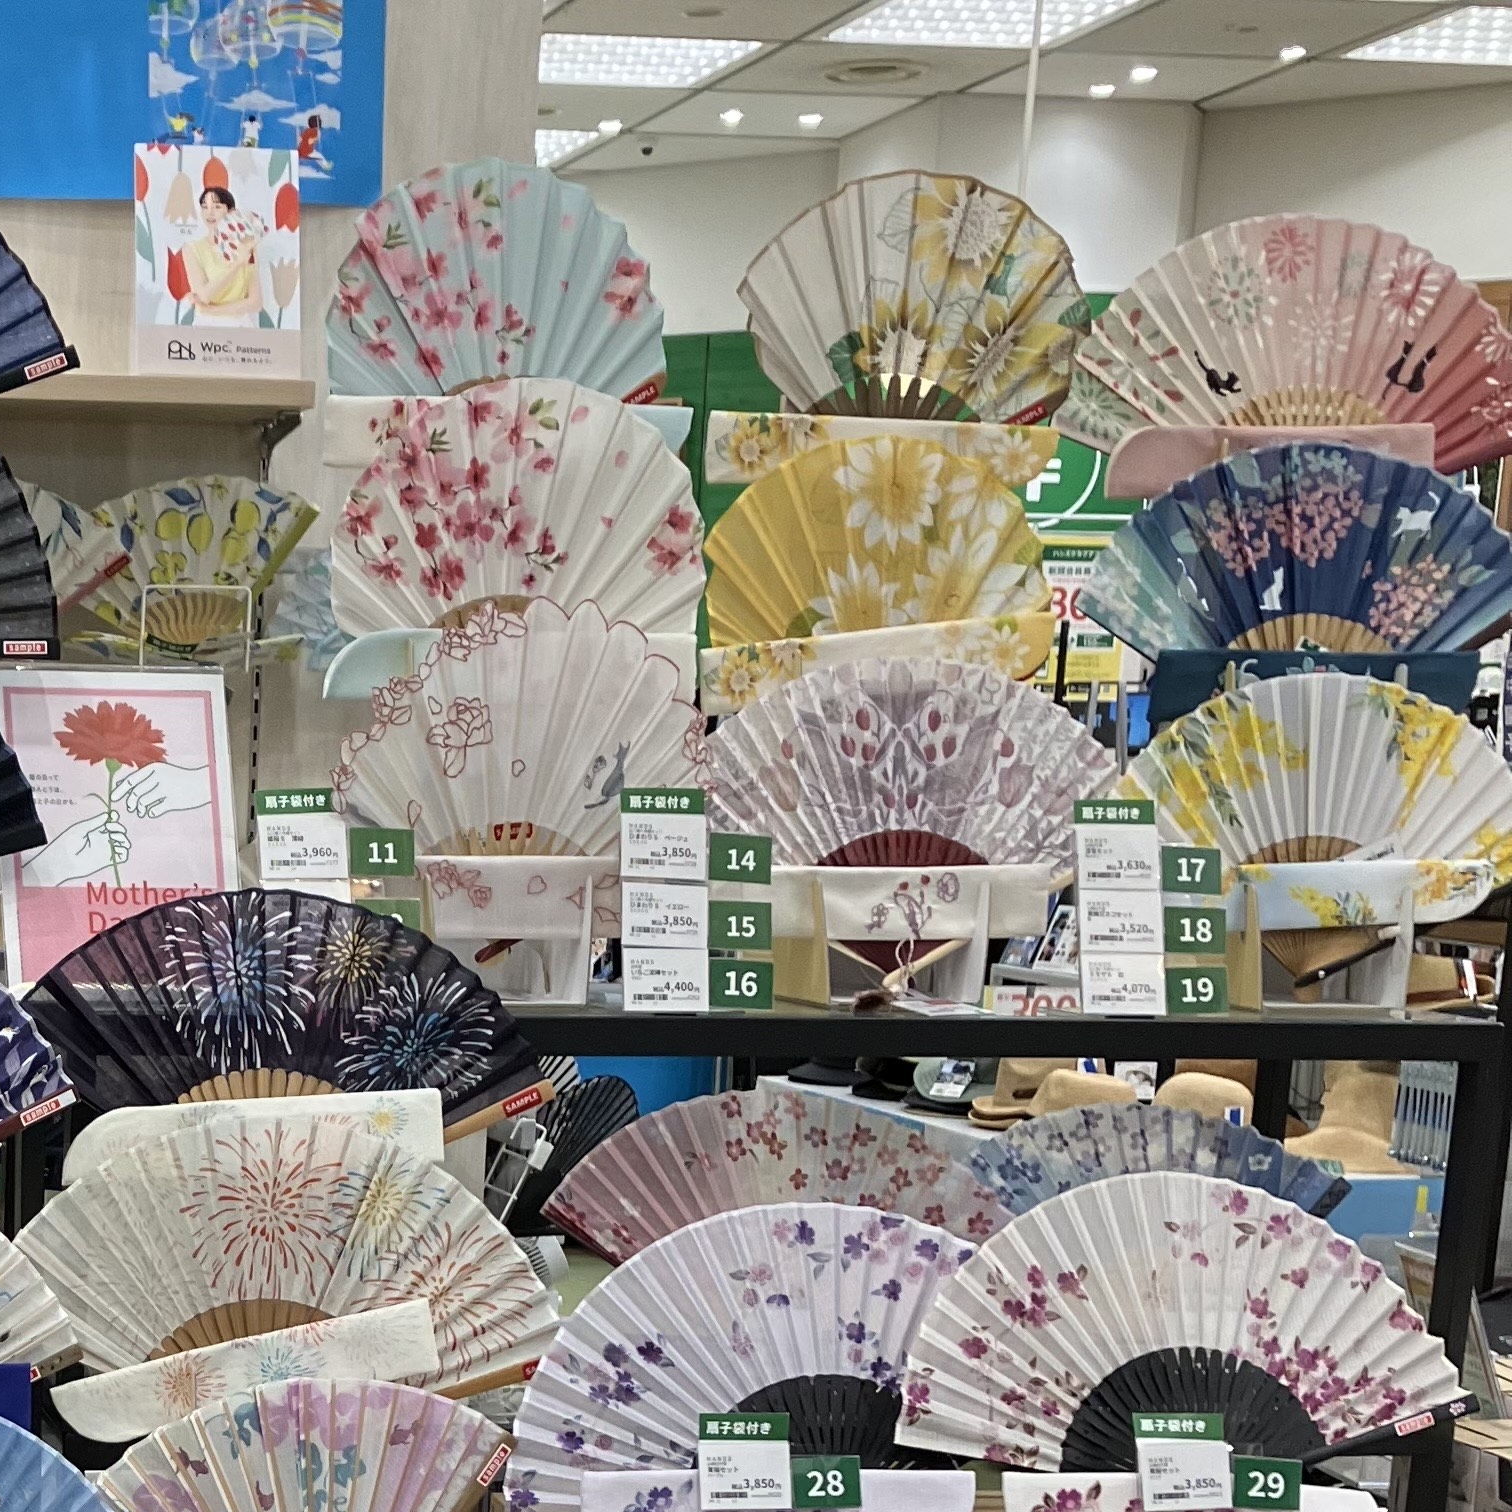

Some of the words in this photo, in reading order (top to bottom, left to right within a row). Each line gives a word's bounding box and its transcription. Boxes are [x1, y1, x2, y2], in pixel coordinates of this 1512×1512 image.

[8, 644, 41, 653] sample
[368, 842, 398, 864] 11
[726, 849, 756, 872] 14
[1177, 858, 1206, 883] 17
[726, 916, 756, 938] 15
[1179, 918, 1213, 943] 18
[724, 971, 758, 996] 16
[1181, 978, 1215, 1003] 19
[505, 1092, 539, 1112] SAMPLE
[482, 1451, 506, 1481] sample
[806, 1470, 845, 1497] 28
[1247, 1471, 1285, 1499] 29
